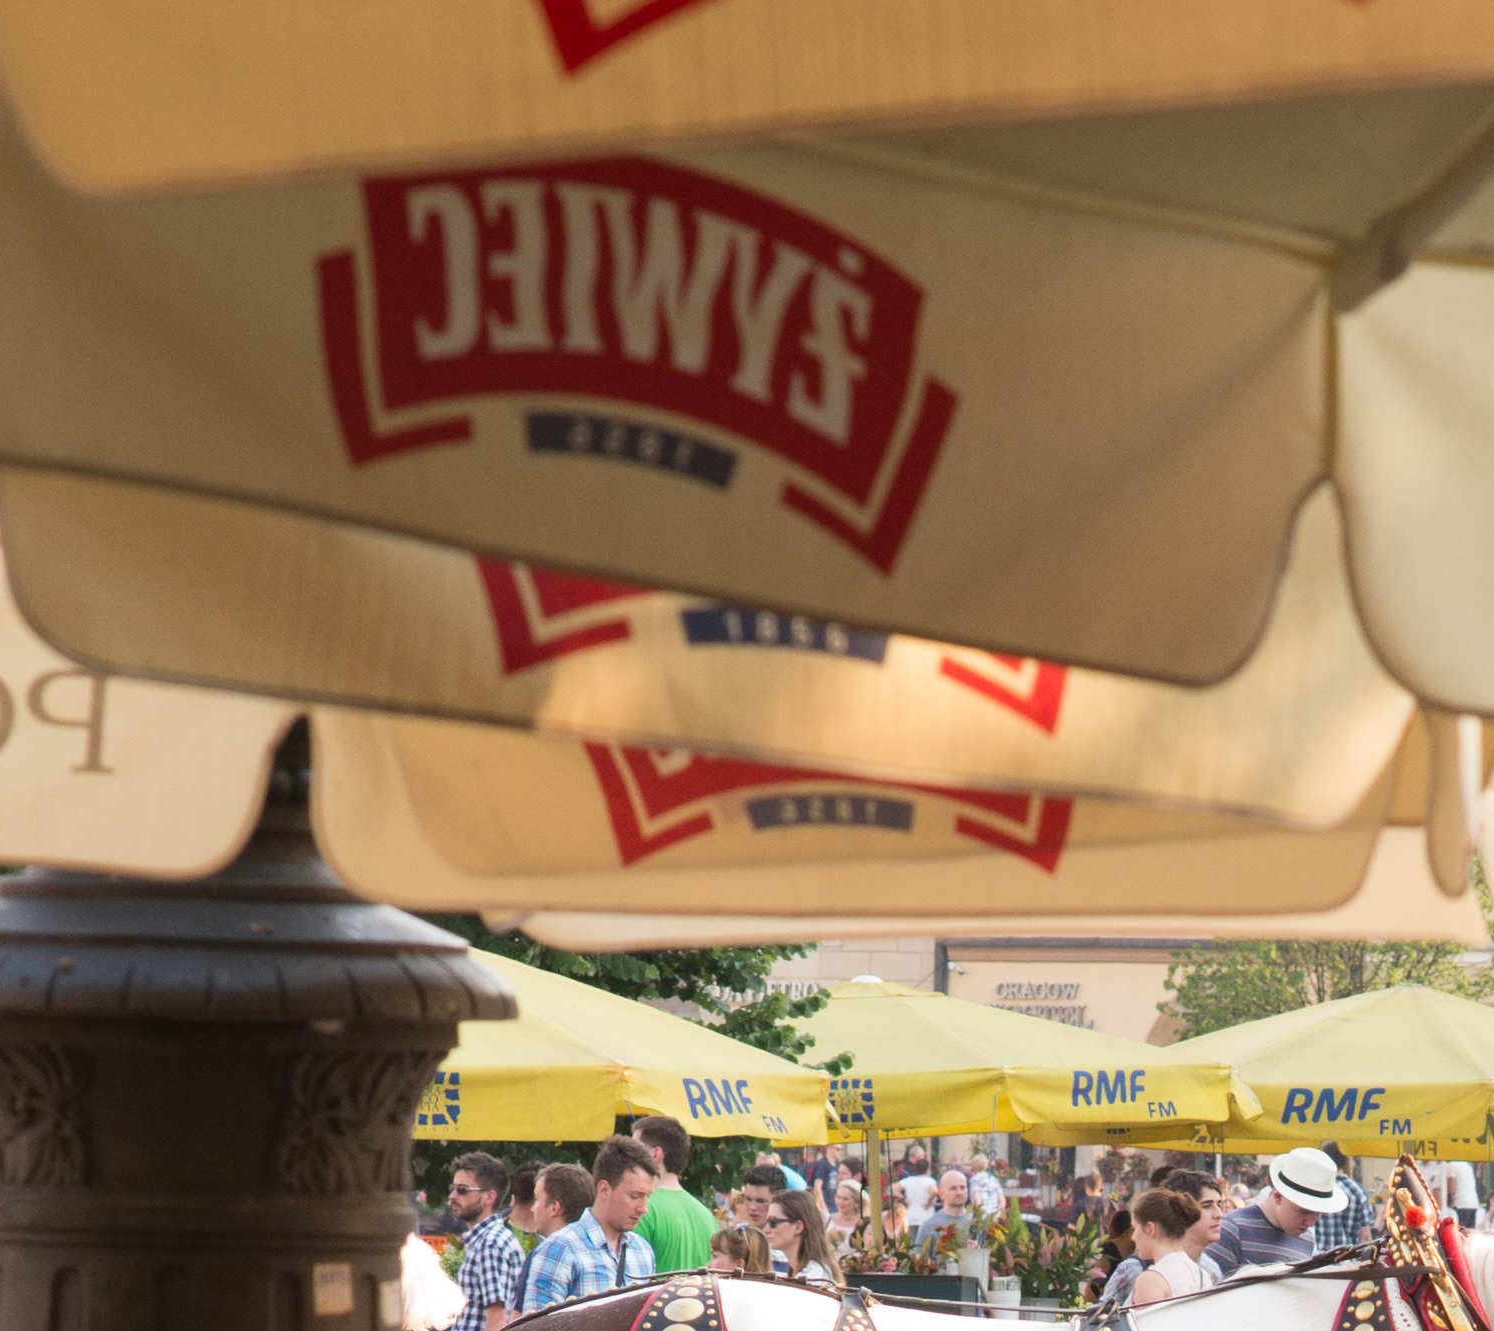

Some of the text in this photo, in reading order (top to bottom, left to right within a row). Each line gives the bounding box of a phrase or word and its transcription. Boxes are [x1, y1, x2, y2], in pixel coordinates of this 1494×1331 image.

[995, 981, 1080, 1000] CRACOW
[989, 1004, 1094, 1030] STEL
[682, 1077, 754, 1119] RMF
[1071, 1070, 1146, 1108] RMF
[1147, 1100, 1177, 1119] FM
[1281, 1087, 1386, 1125] RMF
[762, 1115, 789, 1135] FM
[1379, 1119, 1411, 1135] FM
